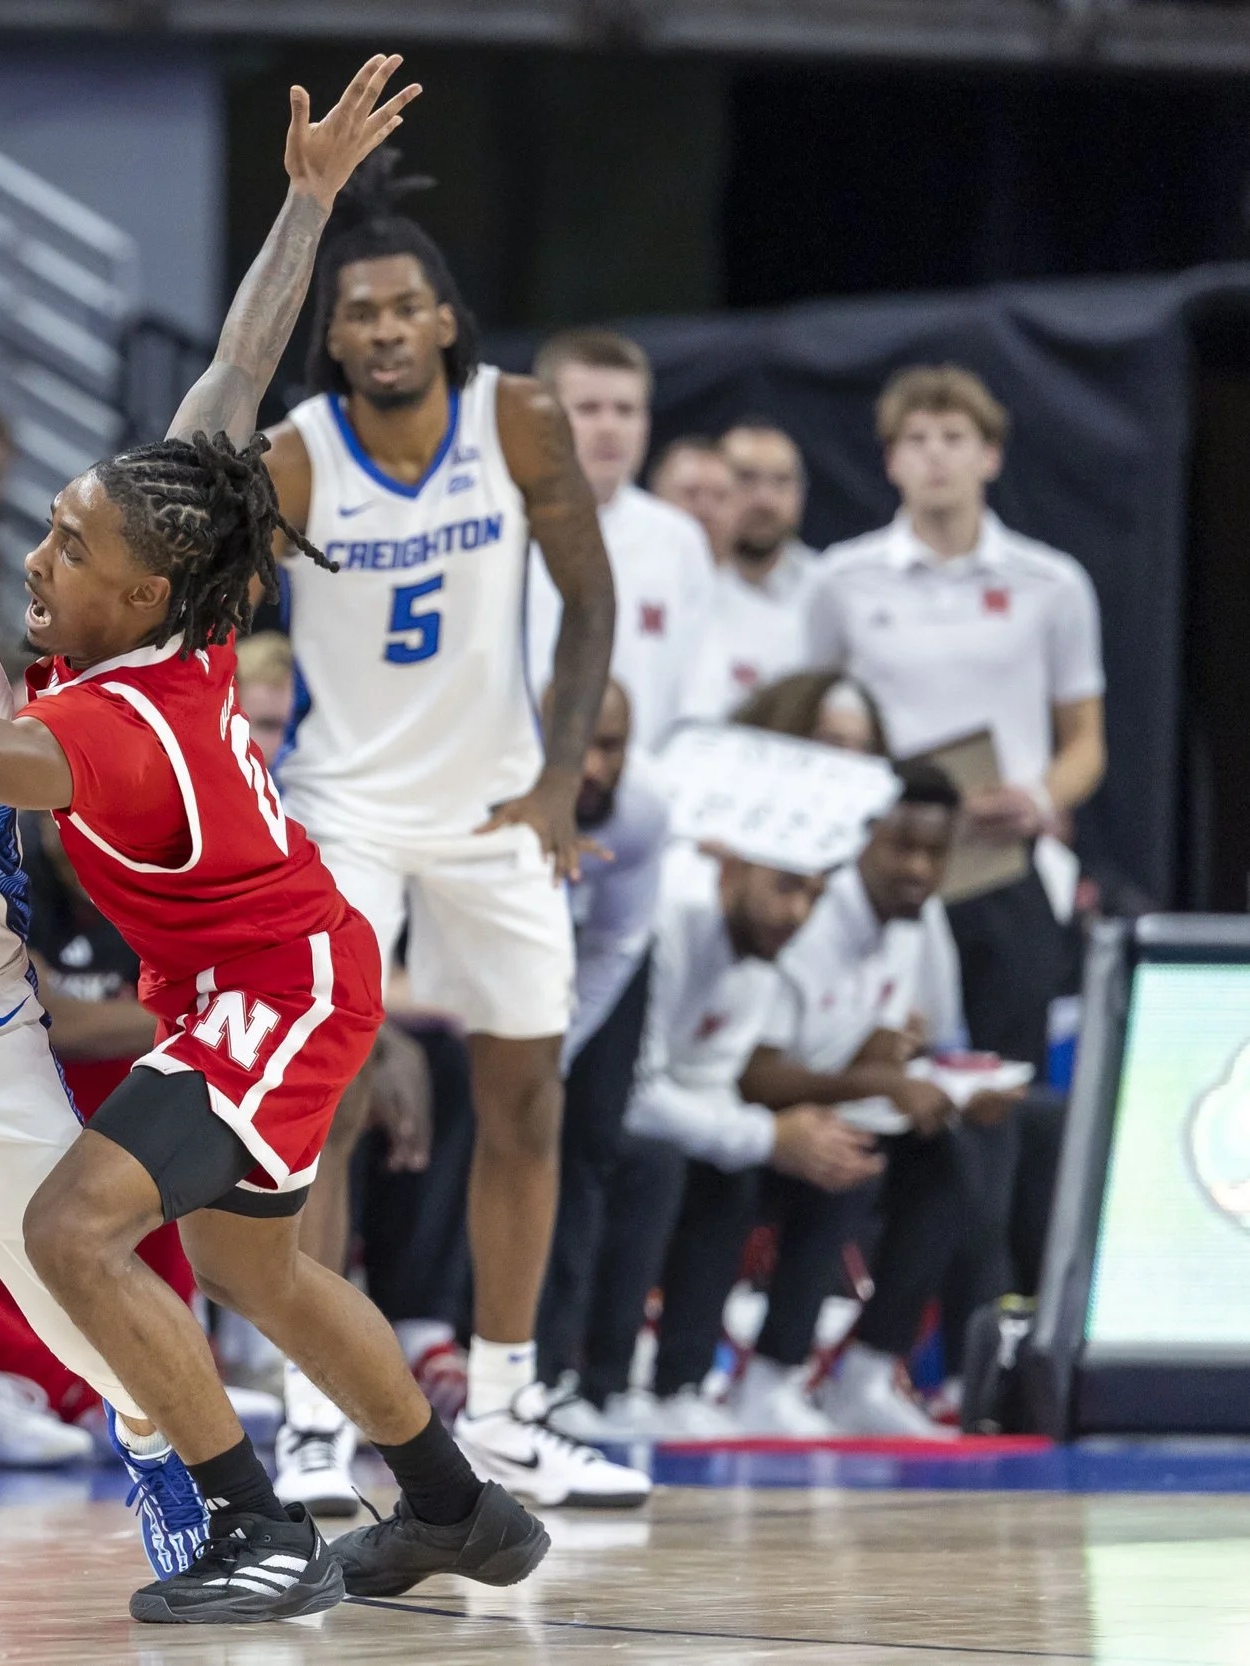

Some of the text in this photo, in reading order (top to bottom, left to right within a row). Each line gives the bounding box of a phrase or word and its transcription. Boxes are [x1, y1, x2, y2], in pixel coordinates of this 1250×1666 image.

[325, 512, 504, 571] CREIGHTON
[384, 573, 444, 666] 5
[191, 989, 281, 1072] N
